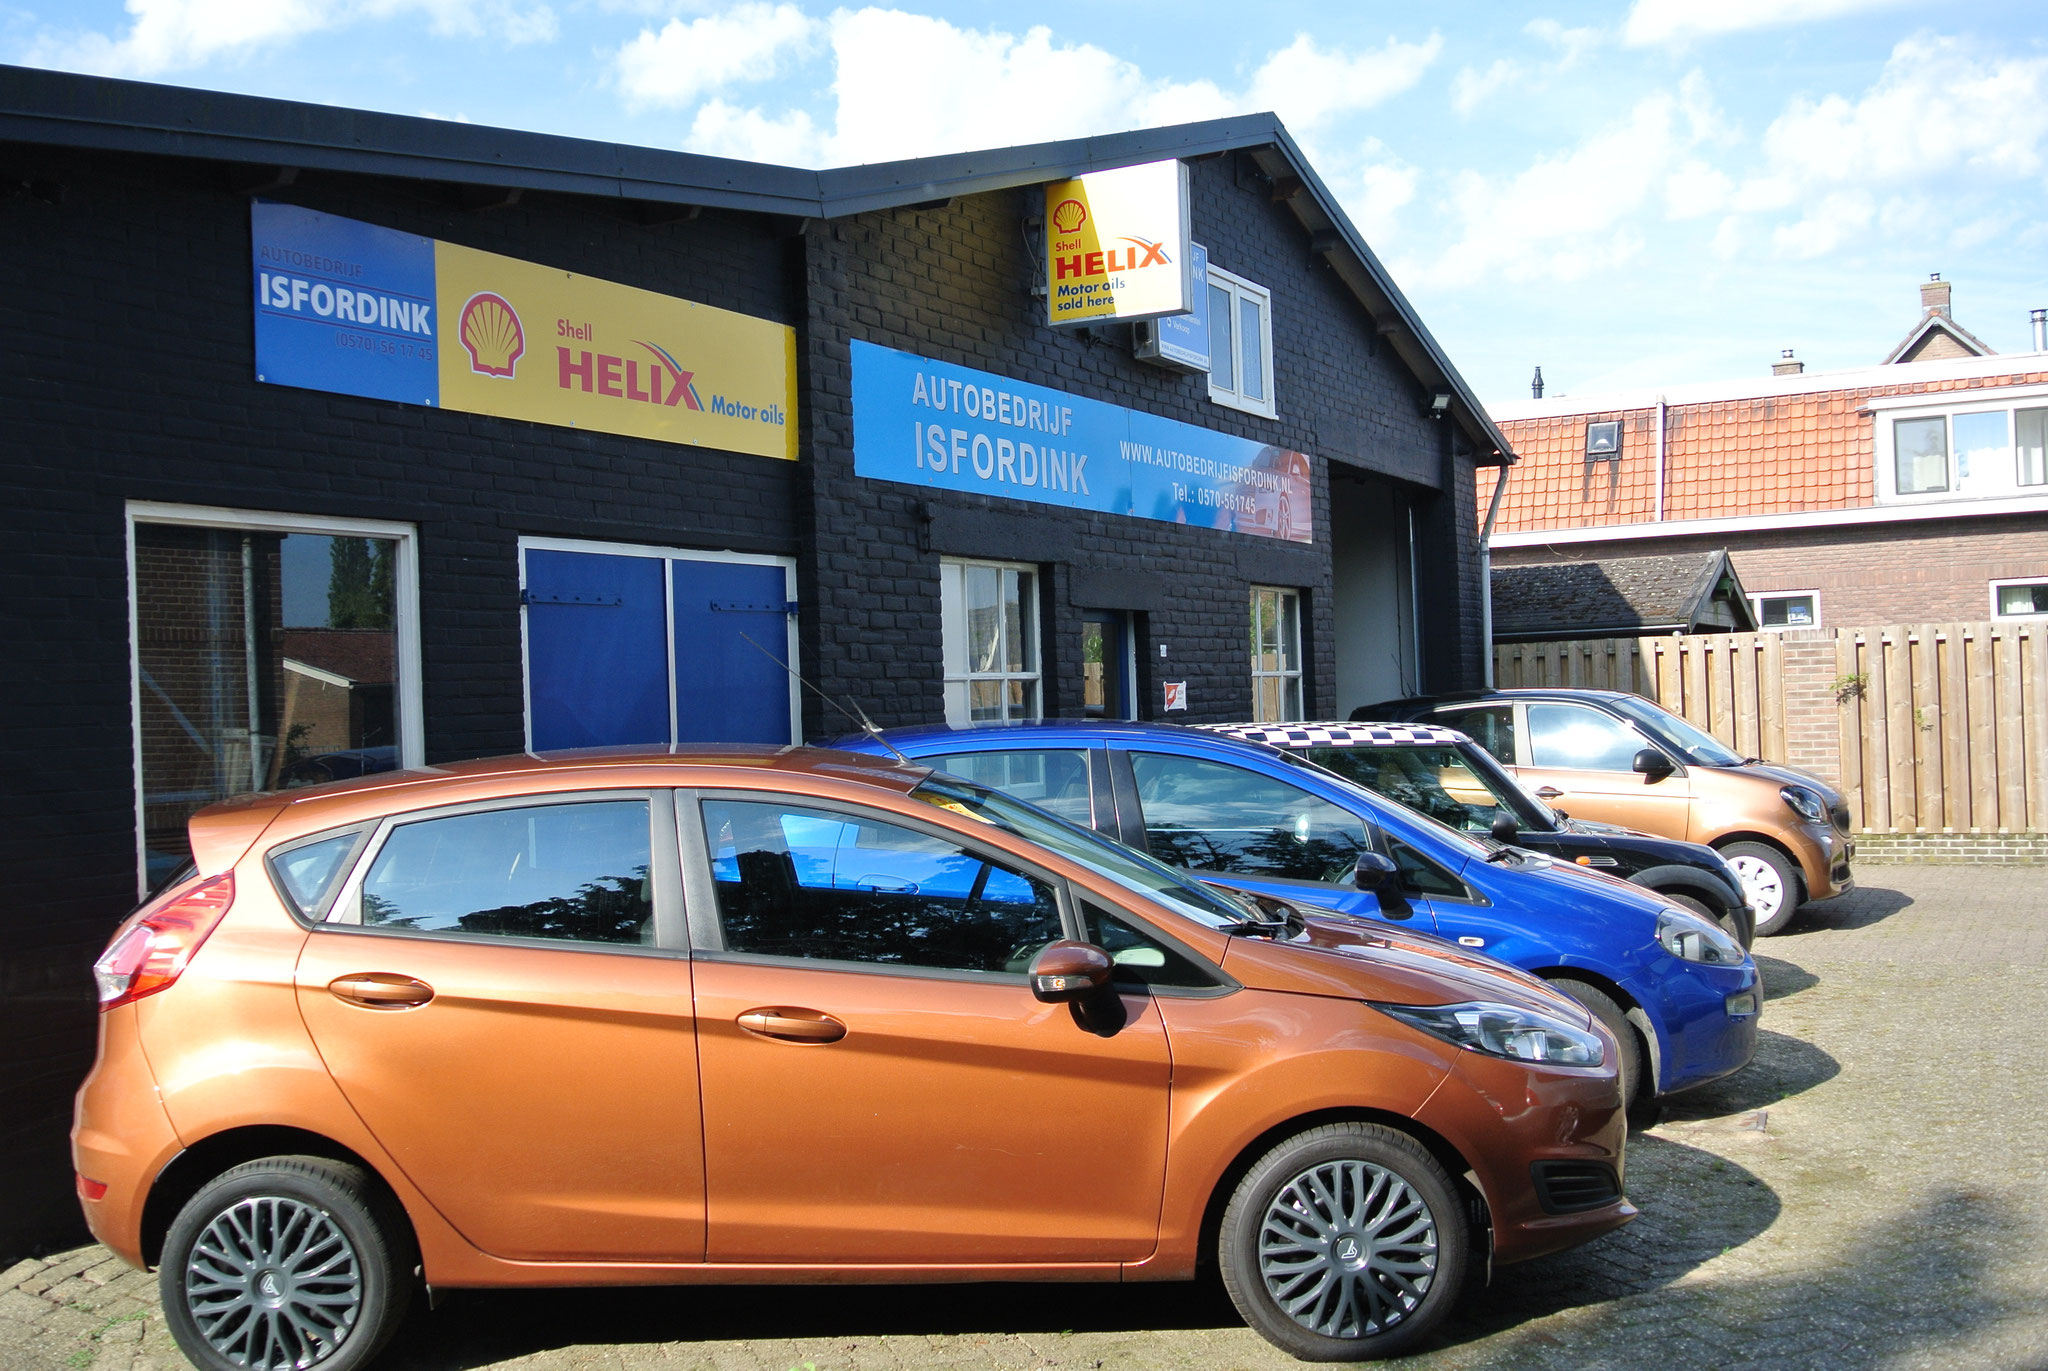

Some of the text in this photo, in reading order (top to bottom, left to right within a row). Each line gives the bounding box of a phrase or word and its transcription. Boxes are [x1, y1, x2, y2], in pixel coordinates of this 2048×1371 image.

[1055, 239, 1168, 280] HELIX
[1056, 239, 1081, 252] Shell
[261, 246, 362, 277] AUTOBEDRIJF
[1057, 277, 1125, 297] Motor oils
[260, 273, 432, 335] ISFORDINK
[1057, 295, 1114, 311] sold here
[557, 319, 592, 342] Shell
[336, 332, 433, 361] (0570) 56 17 45
[556, 341, 700, 411] HELIX
[711, 394, 785, 425] Motor oils
[912, 372, 1073, 437] AUTOBEDRIJF
[915, 421, 1090, 496] ISFORDINK
[1119, 440, 1293, 494] WWW.AUTOBEDRIJFISFORDINK.NL
[1172, 482, 1256, 514] Tel.: 0570-561745
